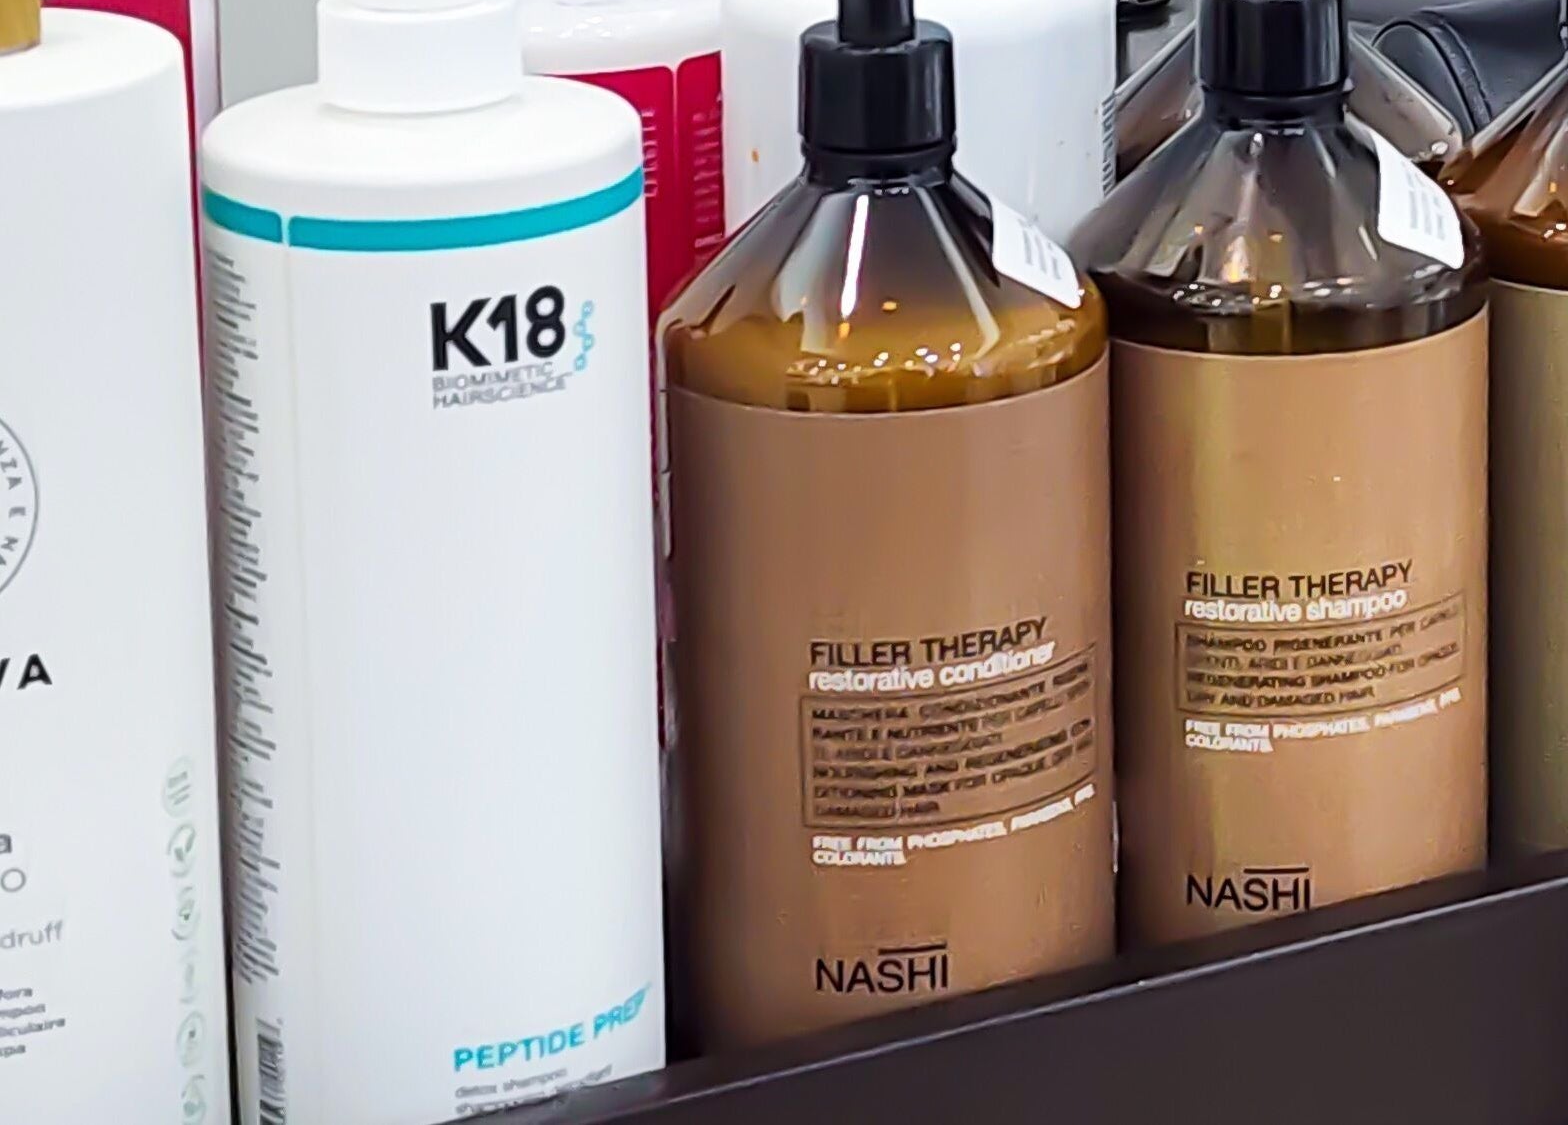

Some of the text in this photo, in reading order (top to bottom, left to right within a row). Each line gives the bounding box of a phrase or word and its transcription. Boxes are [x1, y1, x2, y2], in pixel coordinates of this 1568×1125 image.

[429, 285, 566, 372] K18
[1187, 558, 1413, 599] FILLER THERAPY
[1184, 589, 1407, 622] restorative shampoo
[810, 616, 1047, 666] FILLER THERAPY
[808, 665, 935, 696] restorative
[939, 641, 1056, 686] conditioner
[1186, 873, 1311, 912] NASHI
[816, 953, 949, 994] NASHI
[453, 1022, 585, 1072] PEPTIDE
